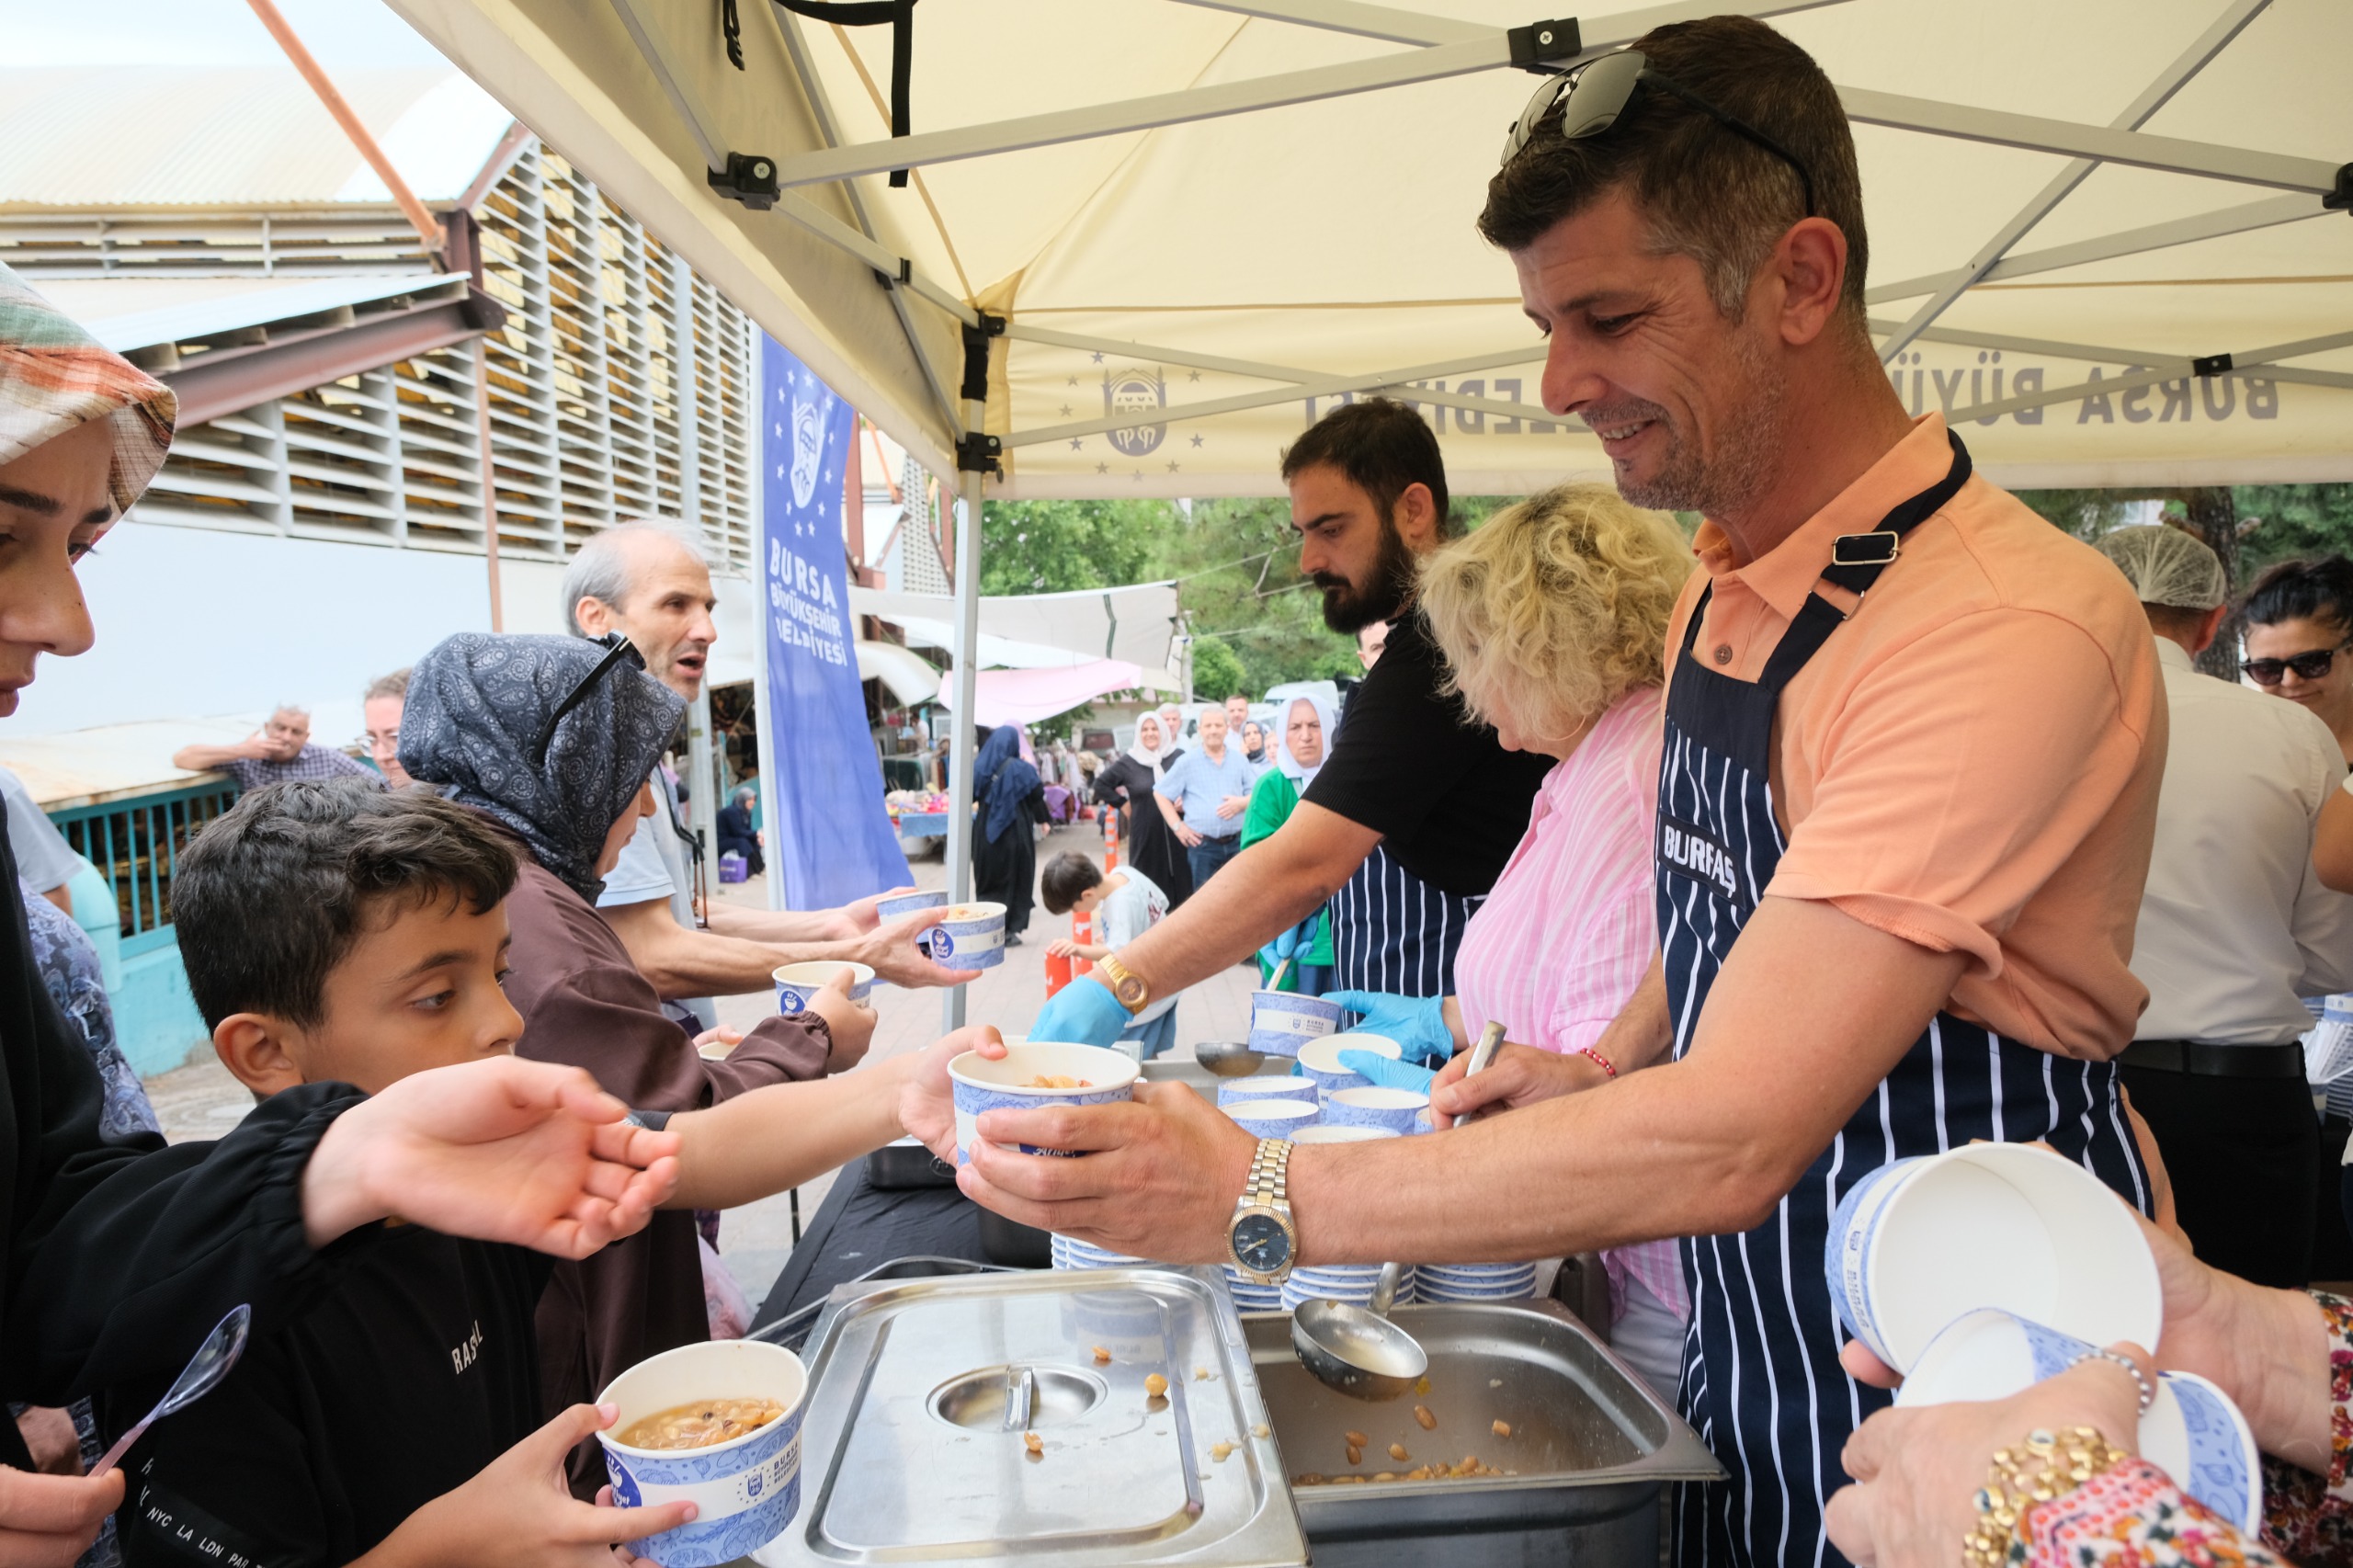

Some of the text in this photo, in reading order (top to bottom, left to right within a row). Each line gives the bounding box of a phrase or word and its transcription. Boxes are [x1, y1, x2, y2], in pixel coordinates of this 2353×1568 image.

[770, 537, 838, 609] BURSA
[1664, 824, 1736, 898] BURFAŞ
[147, 1506, 172, 1527] NYC
[176, 1524, 194, 1541] LA
[199, 1537, 224, 1557] LDN
